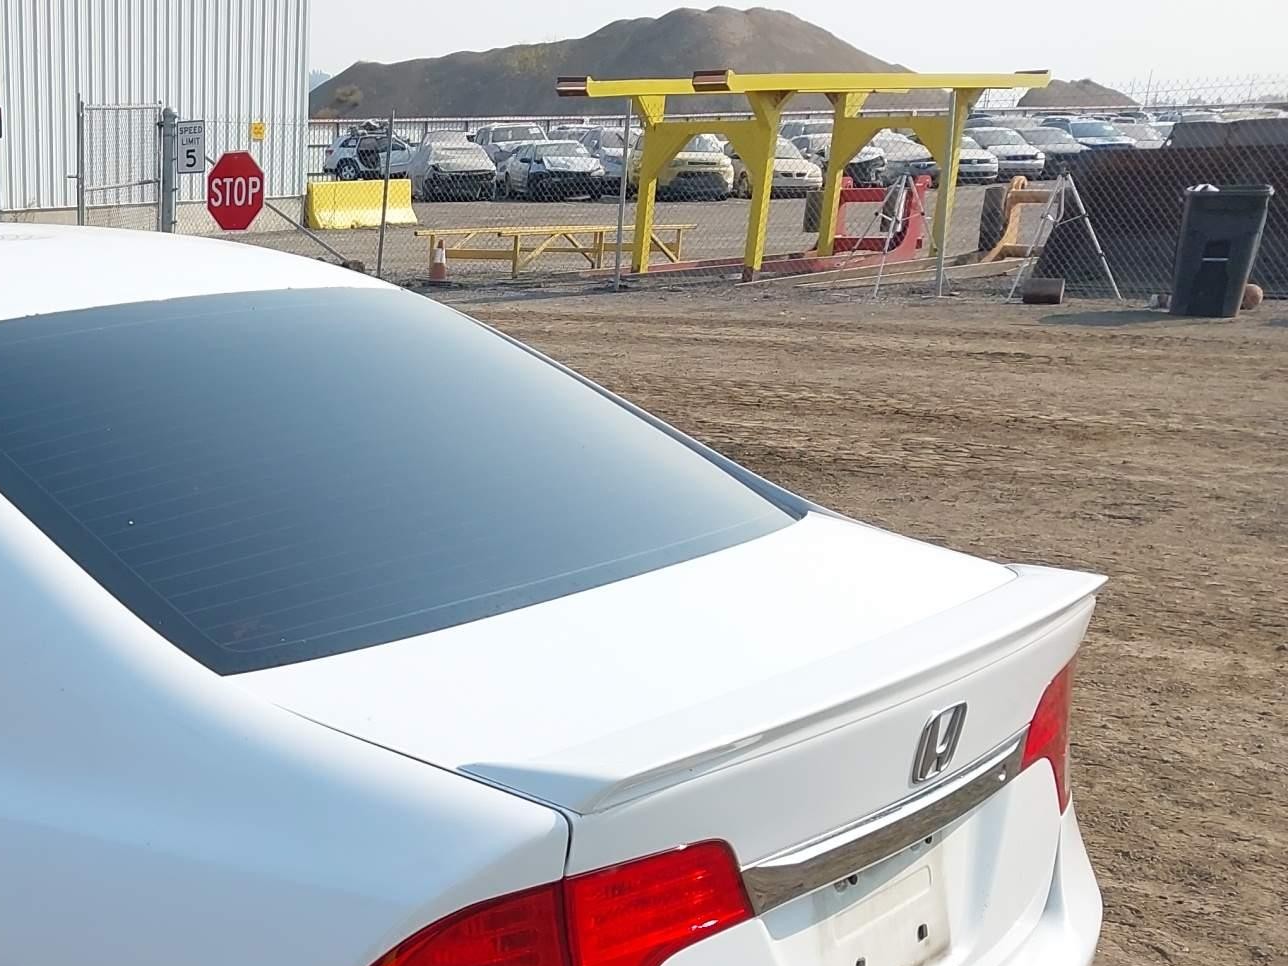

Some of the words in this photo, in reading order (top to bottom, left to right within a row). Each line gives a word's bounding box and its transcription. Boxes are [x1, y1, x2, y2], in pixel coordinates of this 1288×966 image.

[179, 126, 202, 135] SPEED
[181, 137, 201, 146] LIMIT
[185, 149, 197, 168] 5
[210, 176, 261, 207] STOP
